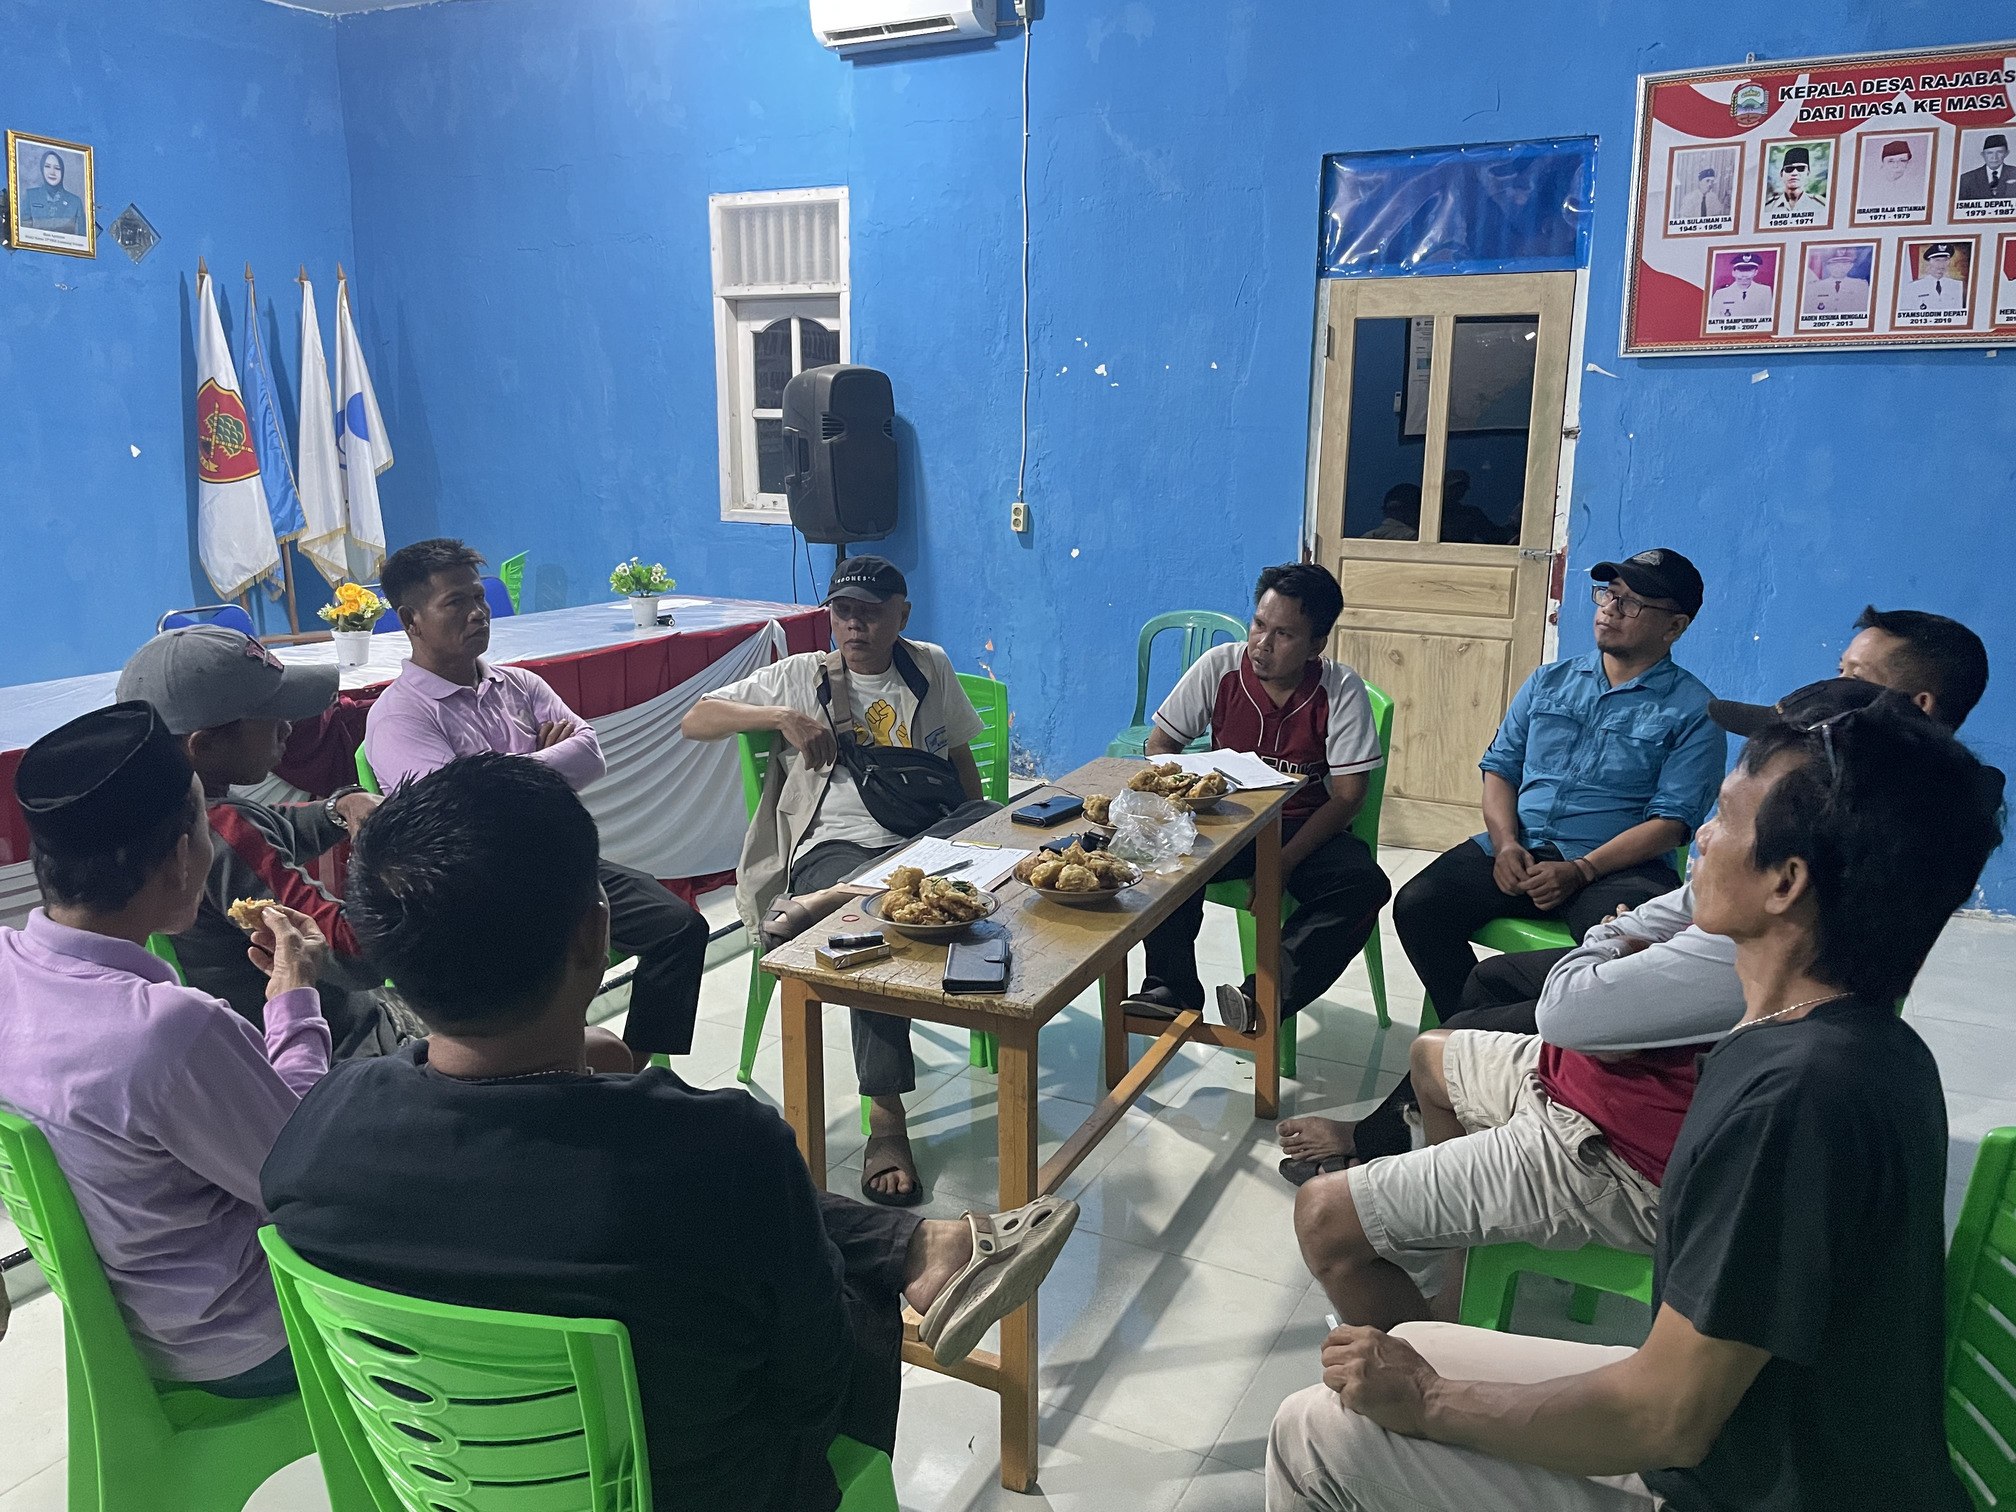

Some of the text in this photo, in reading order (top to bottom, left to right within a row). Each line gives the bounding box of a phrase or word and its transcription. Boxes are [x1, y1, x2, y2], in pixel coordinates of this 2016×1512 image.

[1780, 82, 1855, 101] KEPALA
[1861, 77, 1914, 94] DESA
[1798, 94, 2006, 122] DARI MASA KE MASA
[1956, 201, 1983, 209] ISMAIL
[1965, 209, 1987, 217] 1979
[1994, 208, 2015, 216] 1987
[1687, 217, 1720, 225] SULAIMAN
[1769, 219, 1788, 227] 1956
[1795, 217, 1814, 225] 1971
[1704, 223, 1723, 231] 1956
[1897, 311, 1942, 319] SYAMSUDDIN
